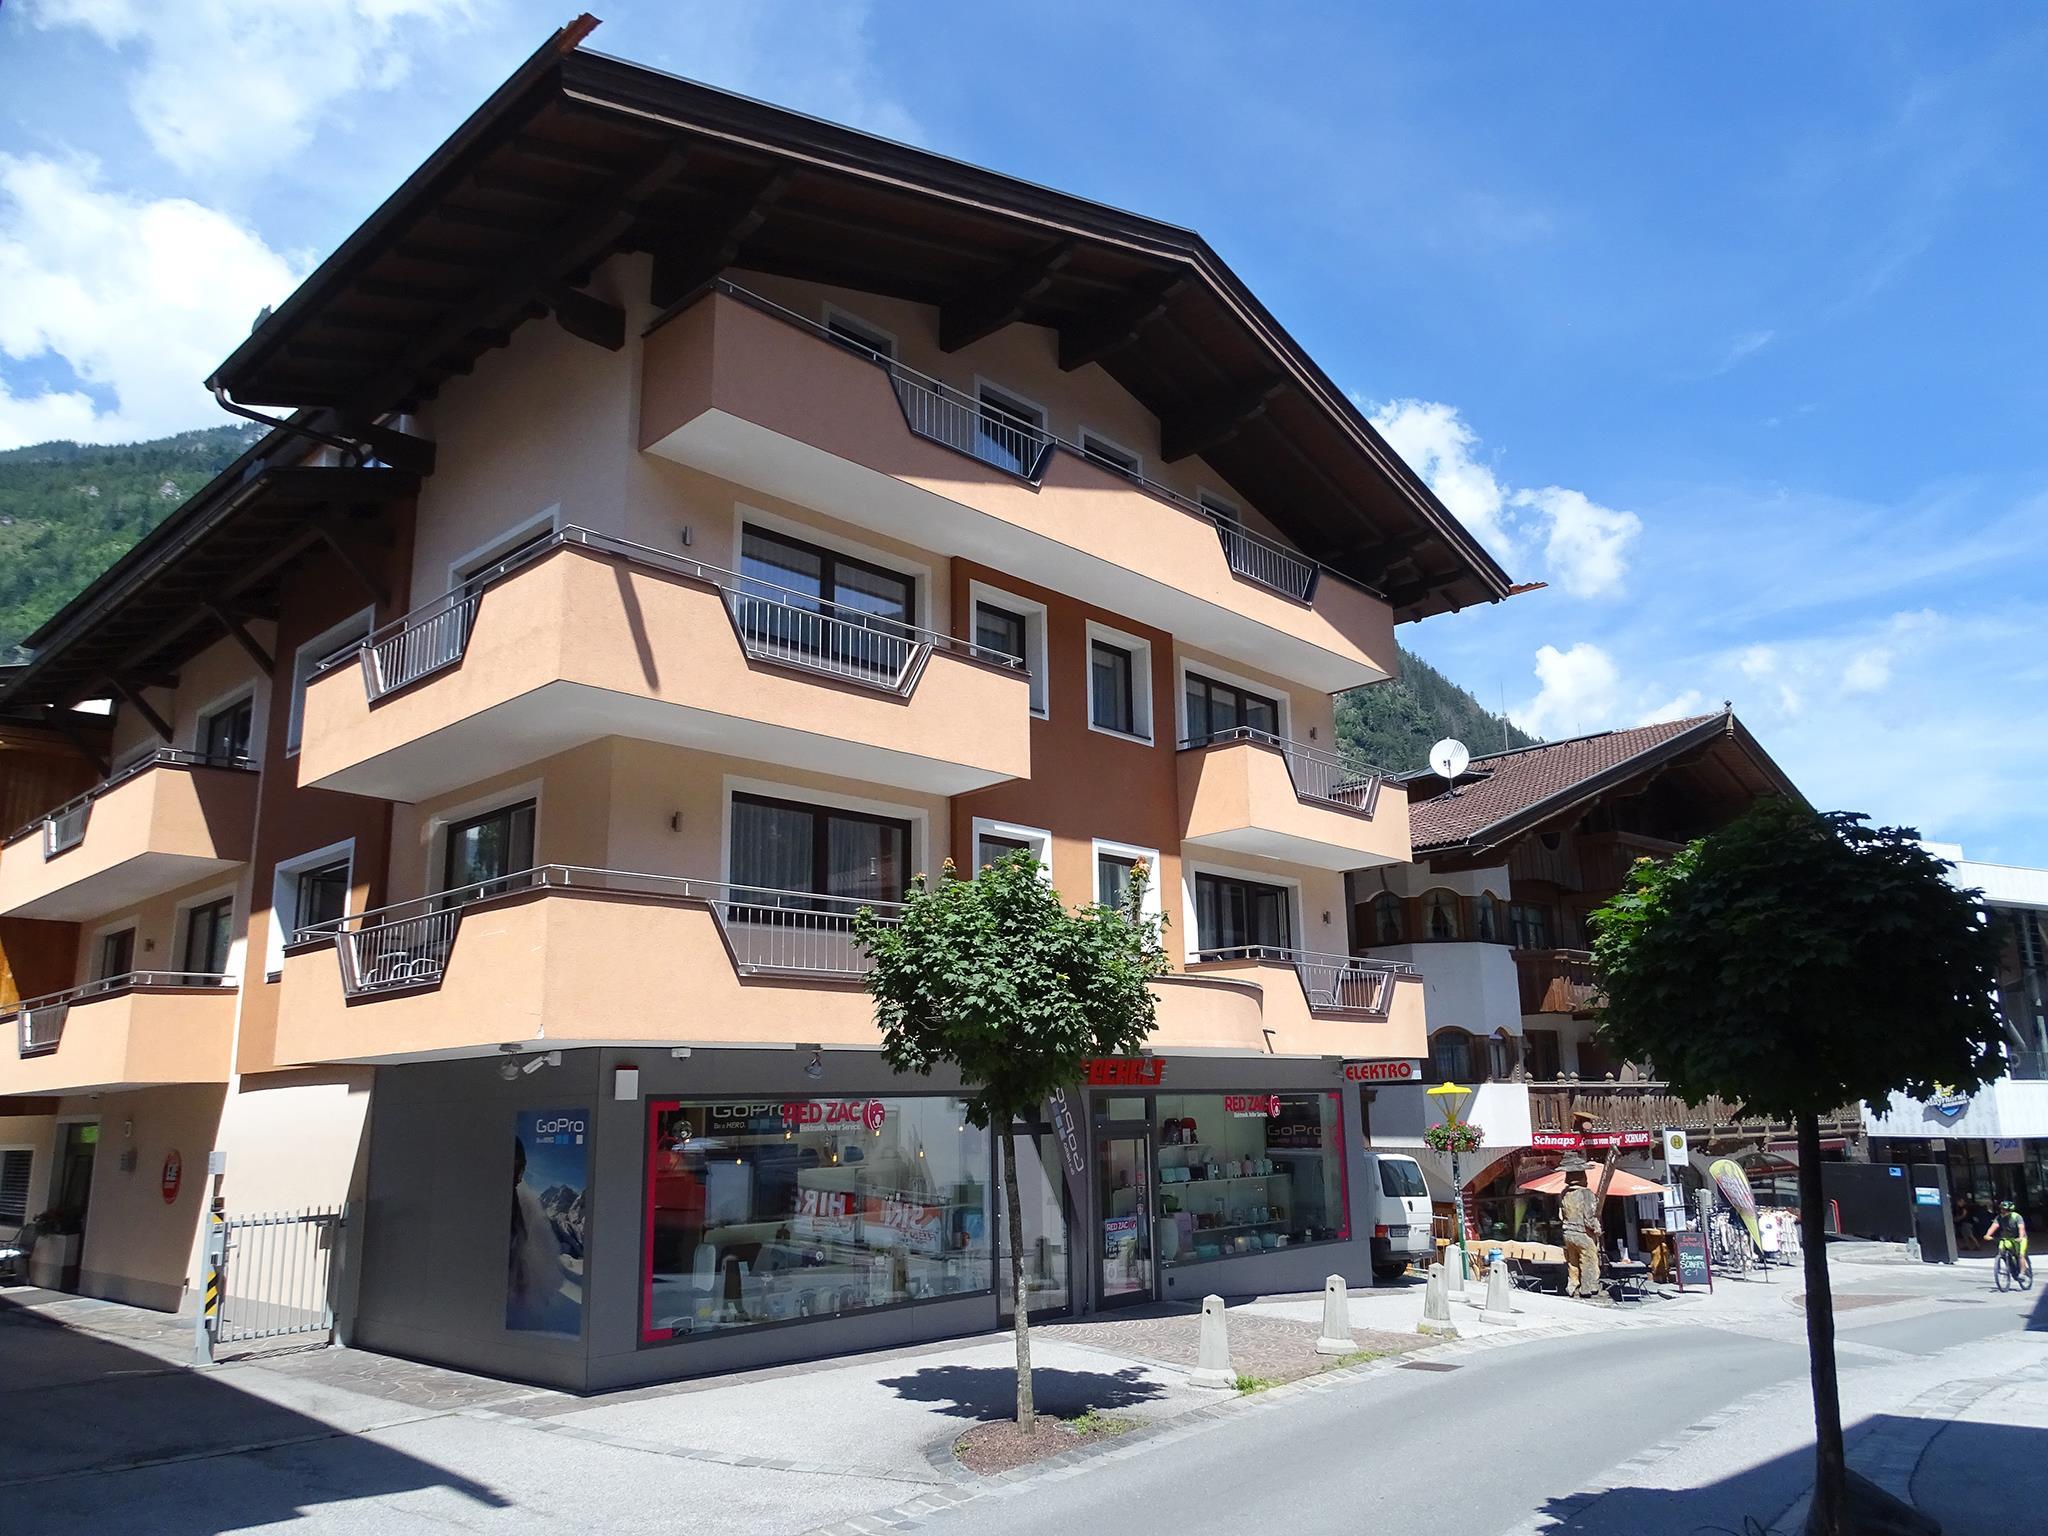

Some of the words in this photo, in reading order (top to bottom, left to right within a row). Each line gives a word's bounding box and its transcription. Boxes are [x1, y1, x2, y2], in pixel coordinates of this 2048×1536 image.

[1345, 1062, 1411, 1080] ELEKTRO
[712, 1103, 793, 1118] GoPro
[1224, 1096, 1246, 1111] RED
[1247, 1095, 1267, 1111] ZAC
[784, 1102, 823, 1124] RED
[825, 1101, 861, 1123] ZAC
[536, 1118, 584, 1133] GoPro
[1267, 1124, 1322, 1136] GoPro
[1533, 1135, 1575, 1146] Schnaps
[1625, 1132, 1649, 1144] SCHNAPS
